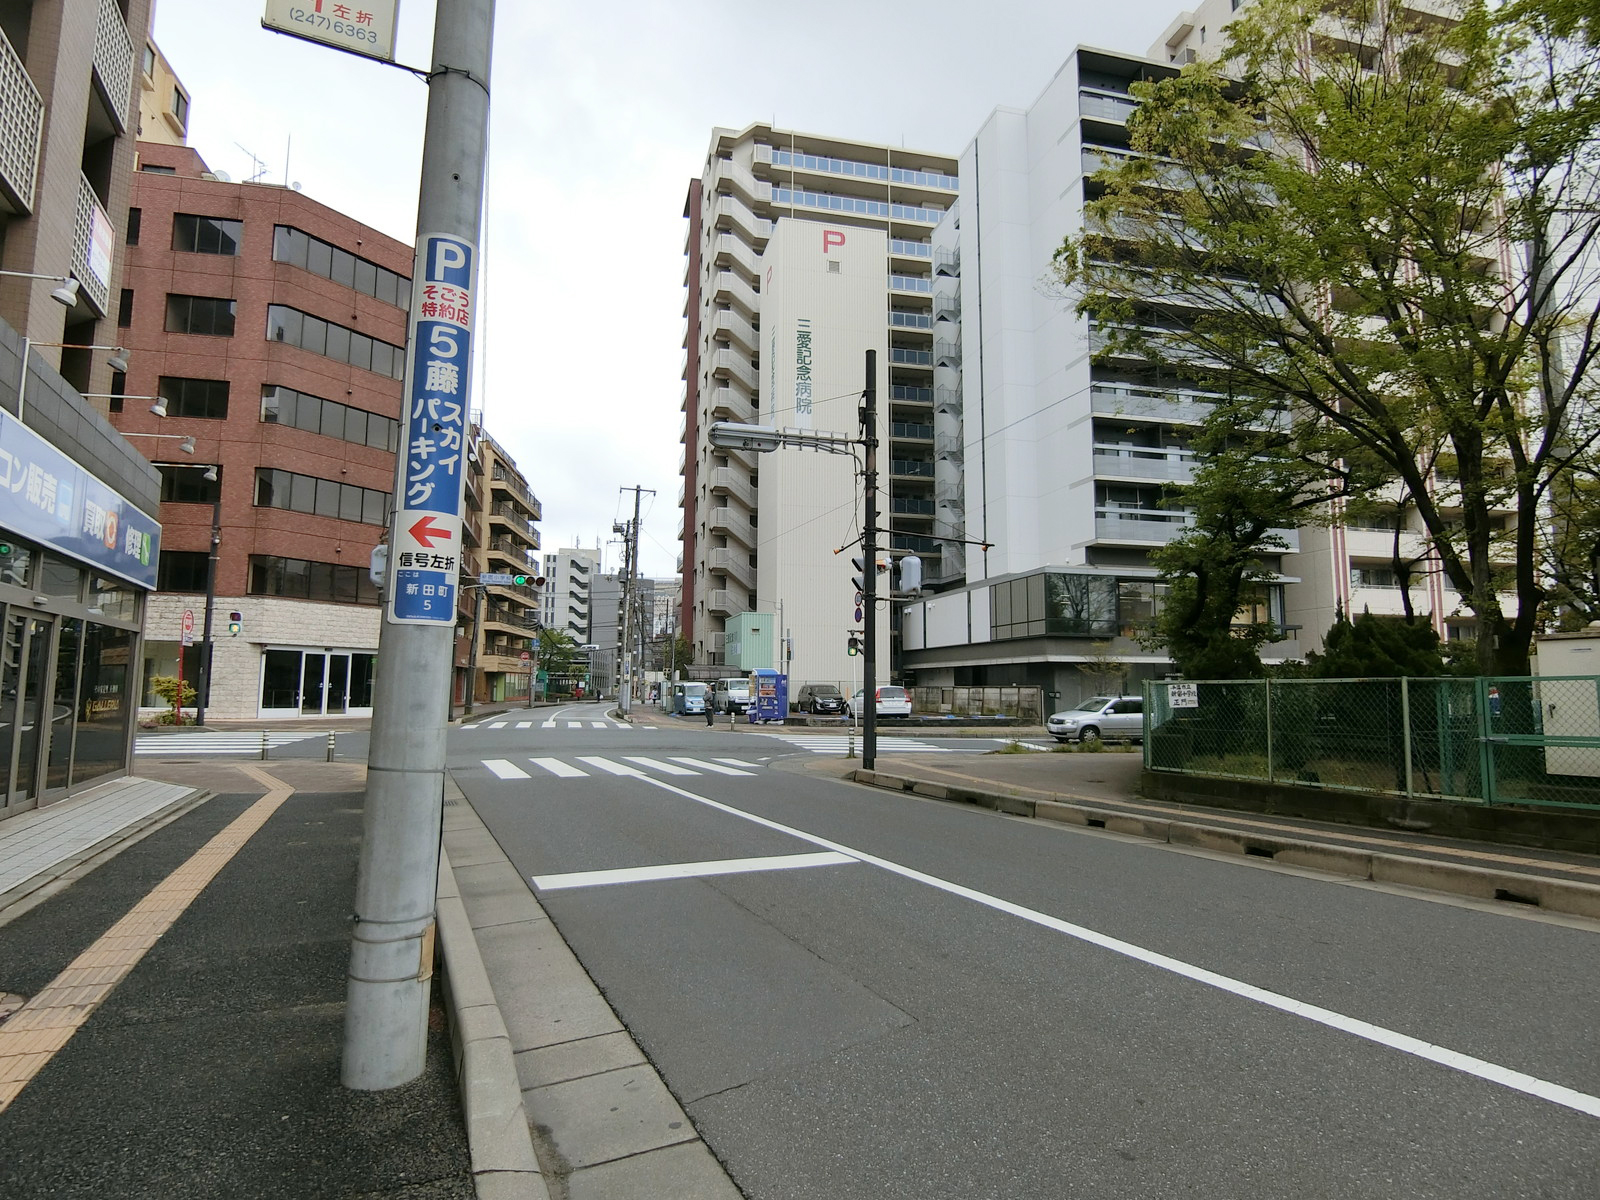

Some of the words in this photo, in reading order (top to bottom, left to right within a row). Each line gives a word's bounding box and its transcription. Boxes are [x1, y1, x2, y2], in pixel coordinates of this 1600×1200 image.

[289, 7, 378, 44] (247)6363
[333, 3, 373, 26] 左折
[823, 229, 846, 254] P
[434, 240, 466, 281] P
[422, 284, 470, 309] そごう
[421, 302, 470, 326] 特約店
[796, 318, 812, 415] 三愛記念病院
[407, 397, 441, 506] パーキング
[437, 400, 464, 476] スカイ
[82, 498, 106, 541] 買取
[125, 523, 142, 560] 修理
[399, 552, 455, 571] 信号左折
[405, 583, 448, 598] 新田町
[423, 599, 432, 611] 5
